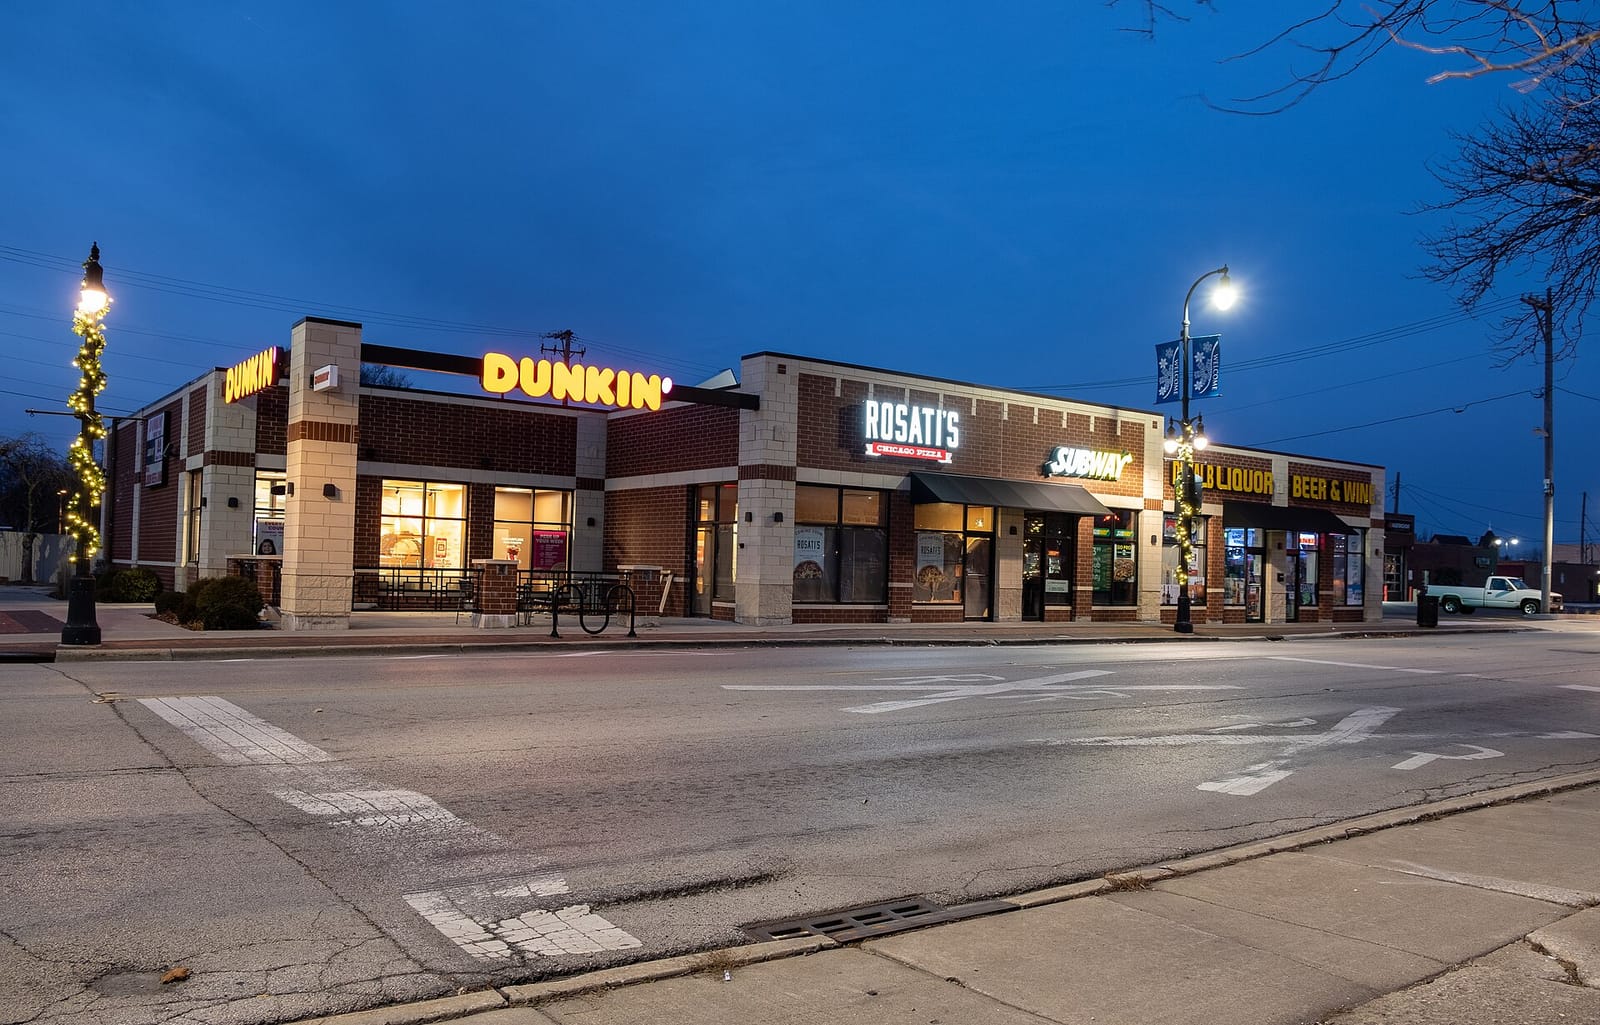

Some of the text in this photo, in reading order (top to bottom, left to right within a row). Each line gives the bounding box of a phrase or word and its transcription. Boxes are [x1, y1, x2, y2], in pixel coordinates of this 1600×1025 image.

[483, 352, 673, 411] DUNKIN'
[865, 399, 959, 449] ROSATI'S
[876, 444, 943, 459] CHICAGO PIZZA
[1049, 446, 1133, 480] SUBWAY
[1216, 465, 1274, 495] LIQUOR
[1292, 475, 1377, 505] BEER & WINE
